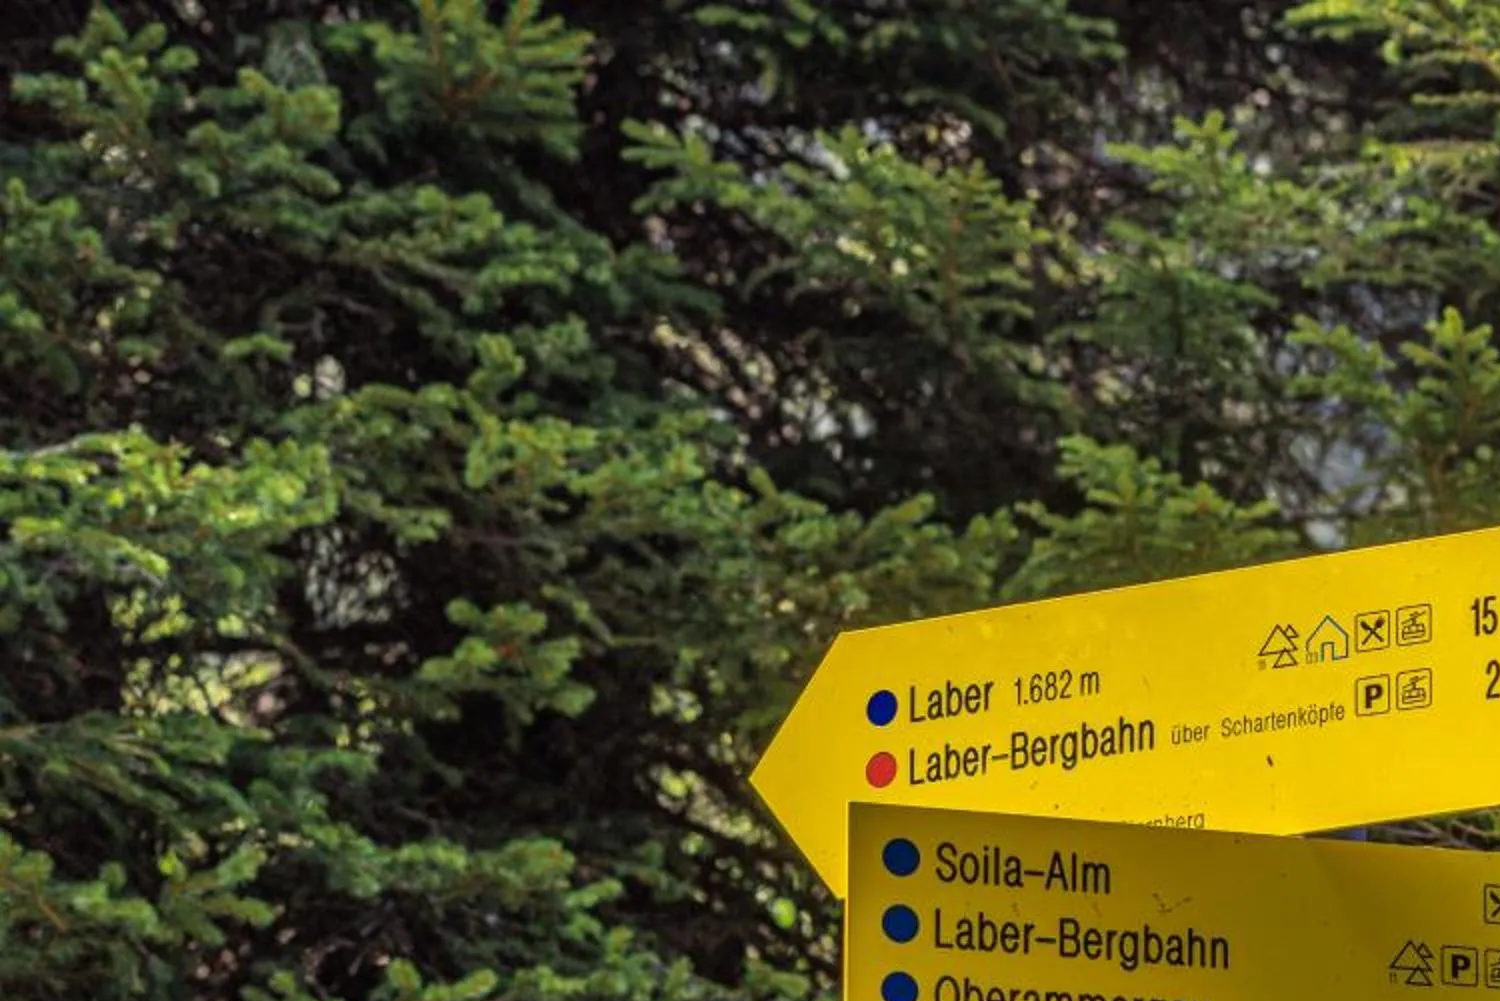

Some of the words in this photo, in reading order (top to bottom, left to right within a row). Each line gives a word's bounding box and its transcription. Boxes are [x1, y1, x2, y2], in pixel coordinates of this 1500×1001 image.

[1470, 595, 1499, 637] 15
[909, 680, 995, 724] Laber
[1013, 669, 1073, 707] 1.682
[1079, 671, 1100, 696] m
[909, 715, 1155, 786] Laber-Bergbahn
[1171, 722, 1211, 745] über
[1221, 702, 1346, 738] Schartenköpfe
[934, 841, 1111, 895] Soila-Alm
[933, 906, 1230, 973] Laber-Bergbahn
